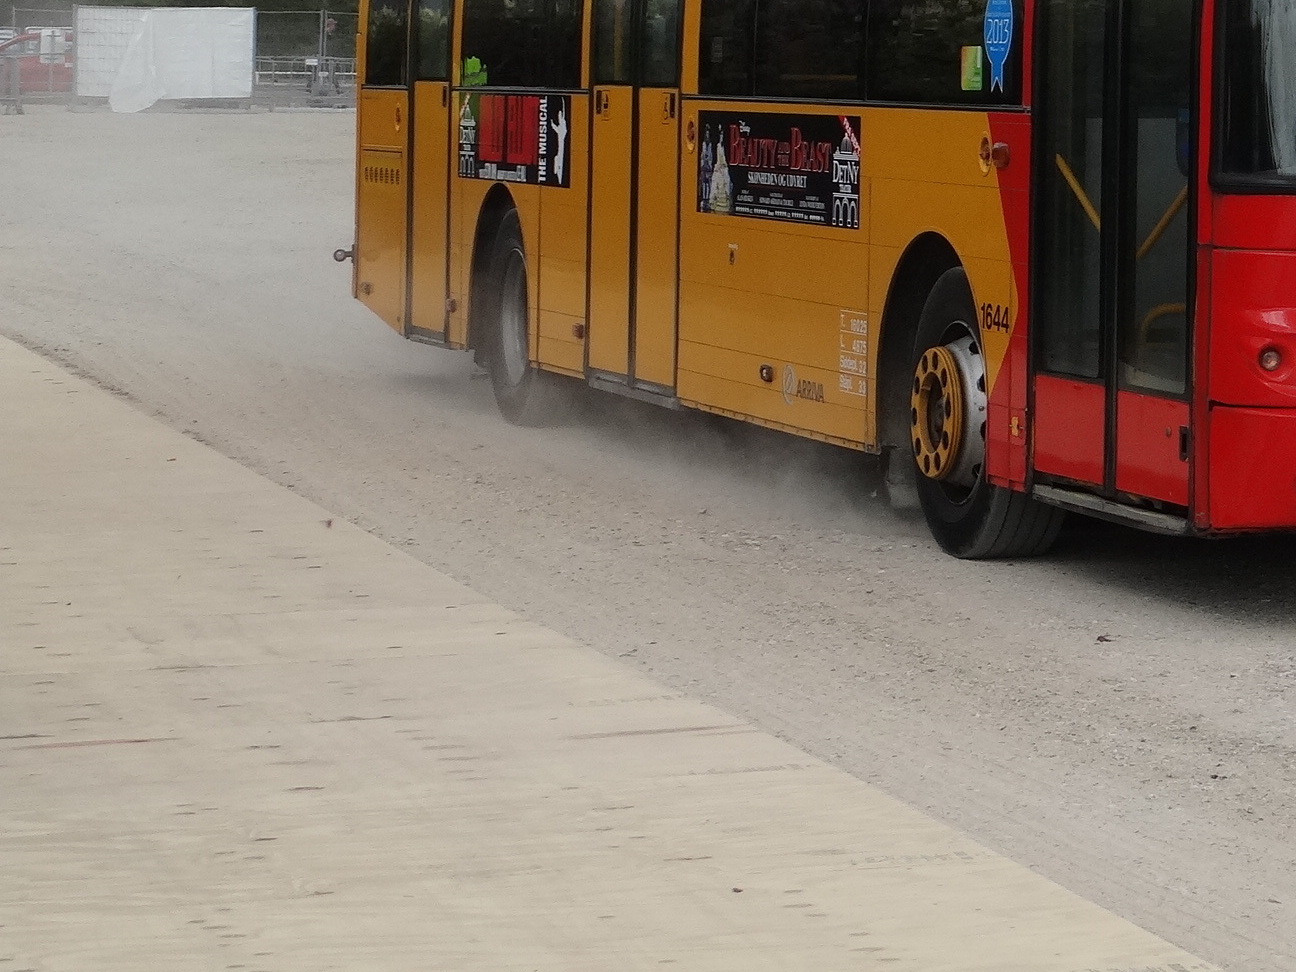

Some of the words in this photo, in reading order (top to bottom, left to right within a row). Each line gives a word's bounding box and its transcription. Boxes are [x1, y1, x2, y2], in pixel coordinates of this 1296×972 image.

[986, 19, 1010, 44] 2013
[538, 95, 548, 155] MUSICAL
[729, 124, 777, 169] BEAUTY
[790, 127, 832, 173] BEAST
[538, 157, 547, 183] THE
[980, 302, 1010, 334] 1644
